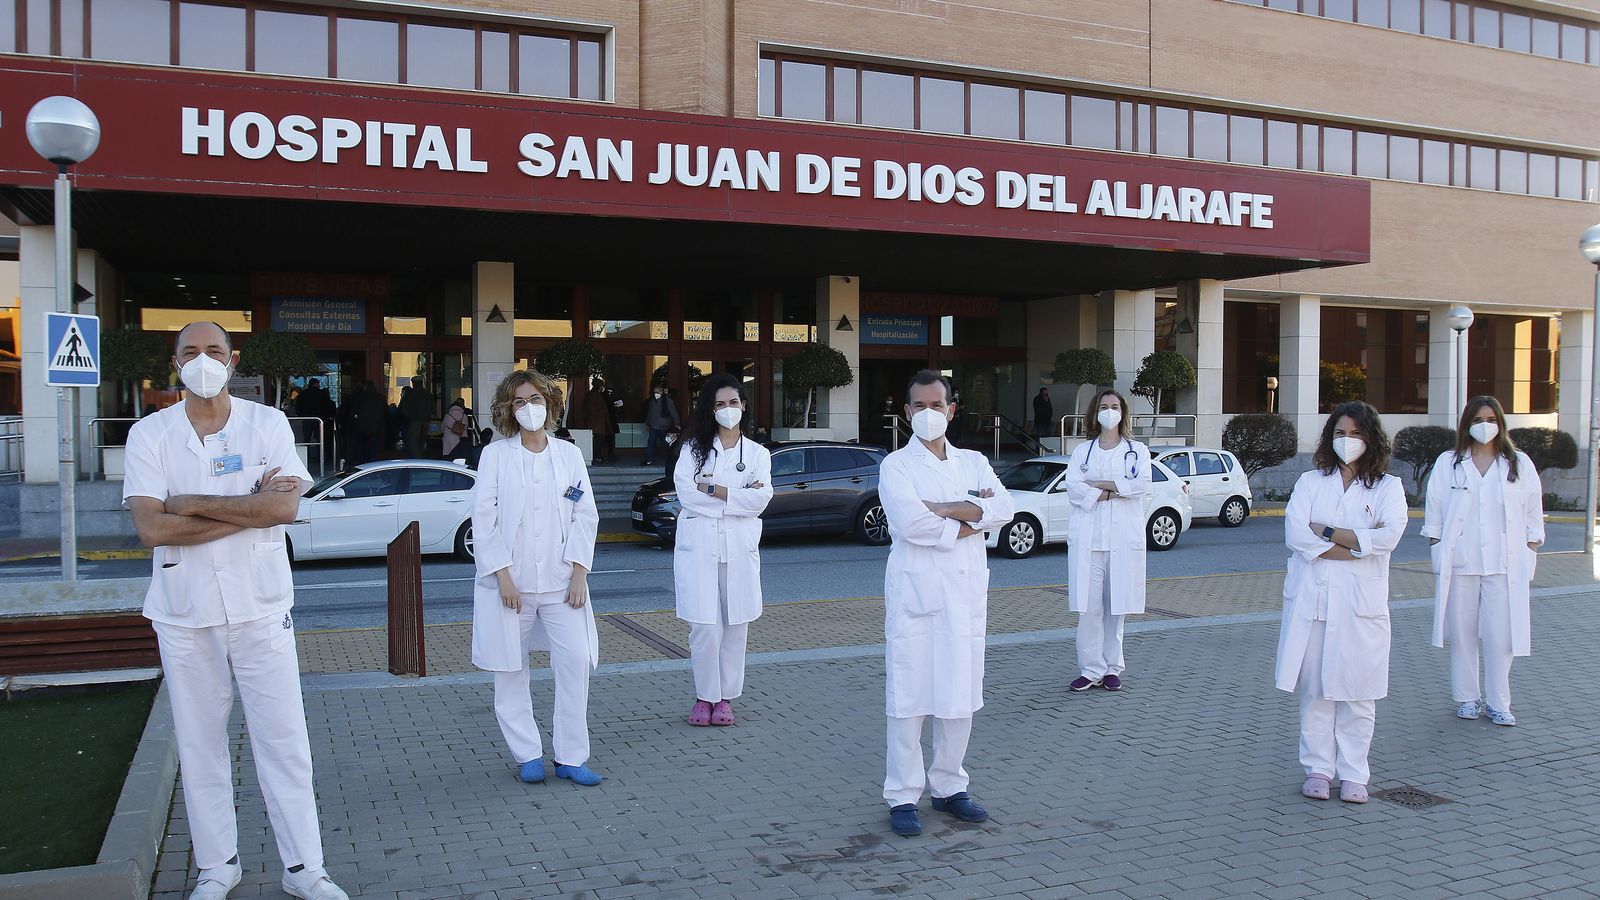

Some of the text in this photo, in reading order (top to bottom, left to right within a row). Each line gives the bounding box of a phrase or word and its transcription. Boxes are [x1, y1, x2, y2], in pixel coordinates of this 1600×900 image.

[181, 106, 1275, 230] HOSPITAL SAN JUAN DE DIOS DEL ALJARAFE
[256, 276, 387, 295] CONSULTAS
[281, 299, 357, 309] Admisión General
[278, 310, 361, 320] Consultas Externas
[287, 321, 352, 331] Hospital de Día
[867, 317, 922, 327] Entrada Principal
[871, 330, 918, 339] Hospitalización
